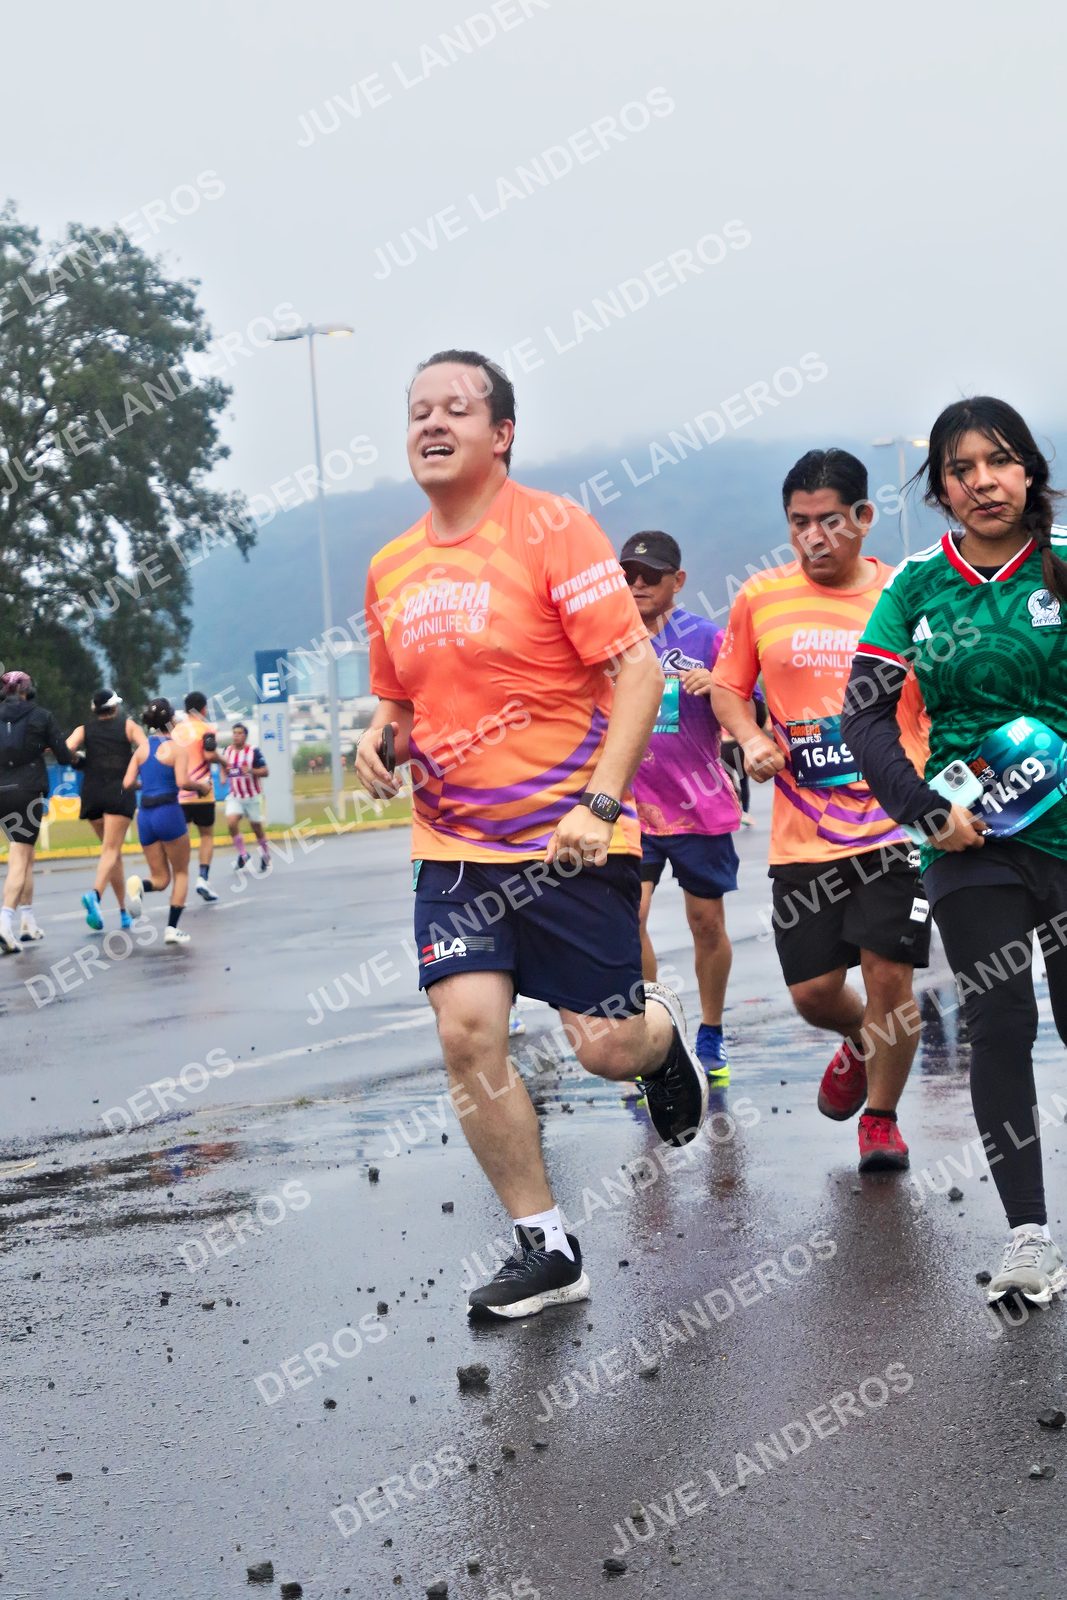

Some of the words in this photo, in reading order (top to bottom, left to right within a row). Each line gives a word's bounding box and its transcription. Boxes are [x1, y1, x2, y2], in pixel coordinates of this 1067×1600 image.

[403, 581, 490, 625] CARRERA
[565, 579, 614, 615] IMPULSA
[402, 614, 463, 648] OMNILIFE
[262, 672, 281, 697] E
[1007, 715, 1034, 746] 10K
[981, 757, 1046, 813] 1419
